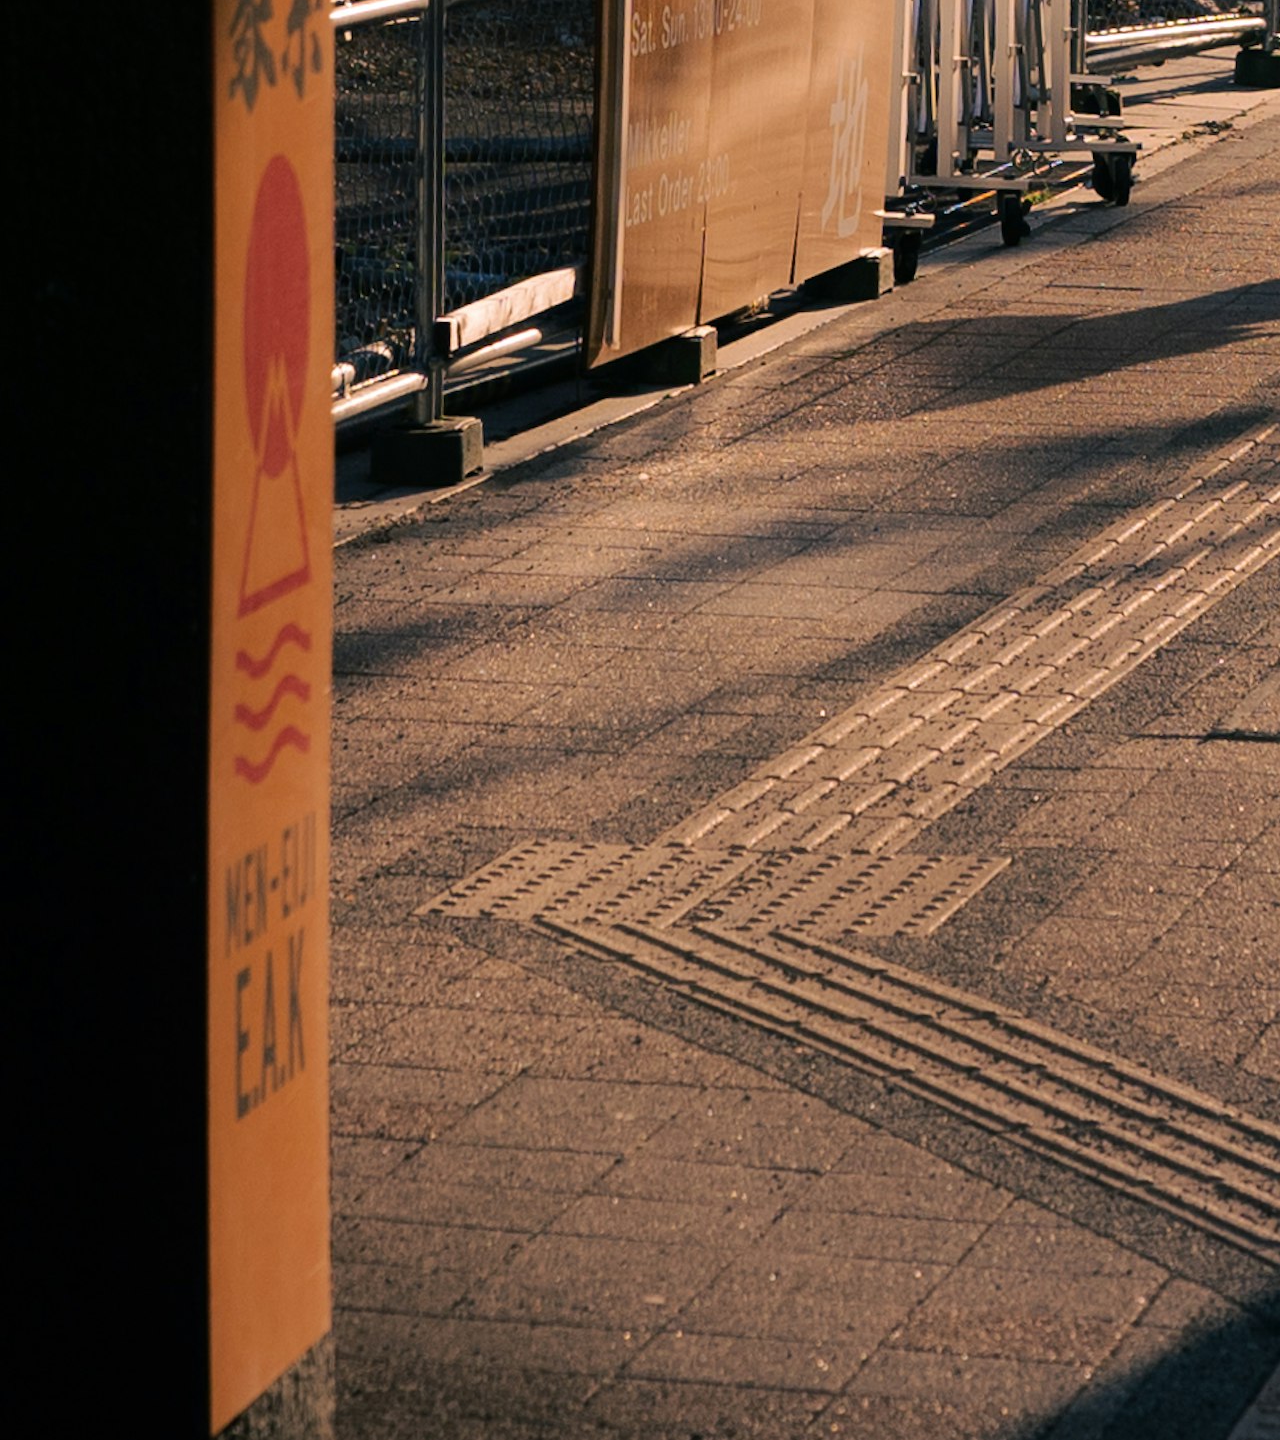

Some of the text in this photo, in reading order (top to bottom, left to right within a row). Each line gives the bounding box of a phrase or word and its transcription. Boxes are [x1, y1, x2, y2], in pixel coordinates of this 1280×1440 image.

[630, 10, 657, 57] Sat.
[661, 4, 690, 50] Sun.
[624, 184, 654, 228] Last
[657, 171, 695, 217] Order
[224, 811, 317, 959] MEN-EIJI
